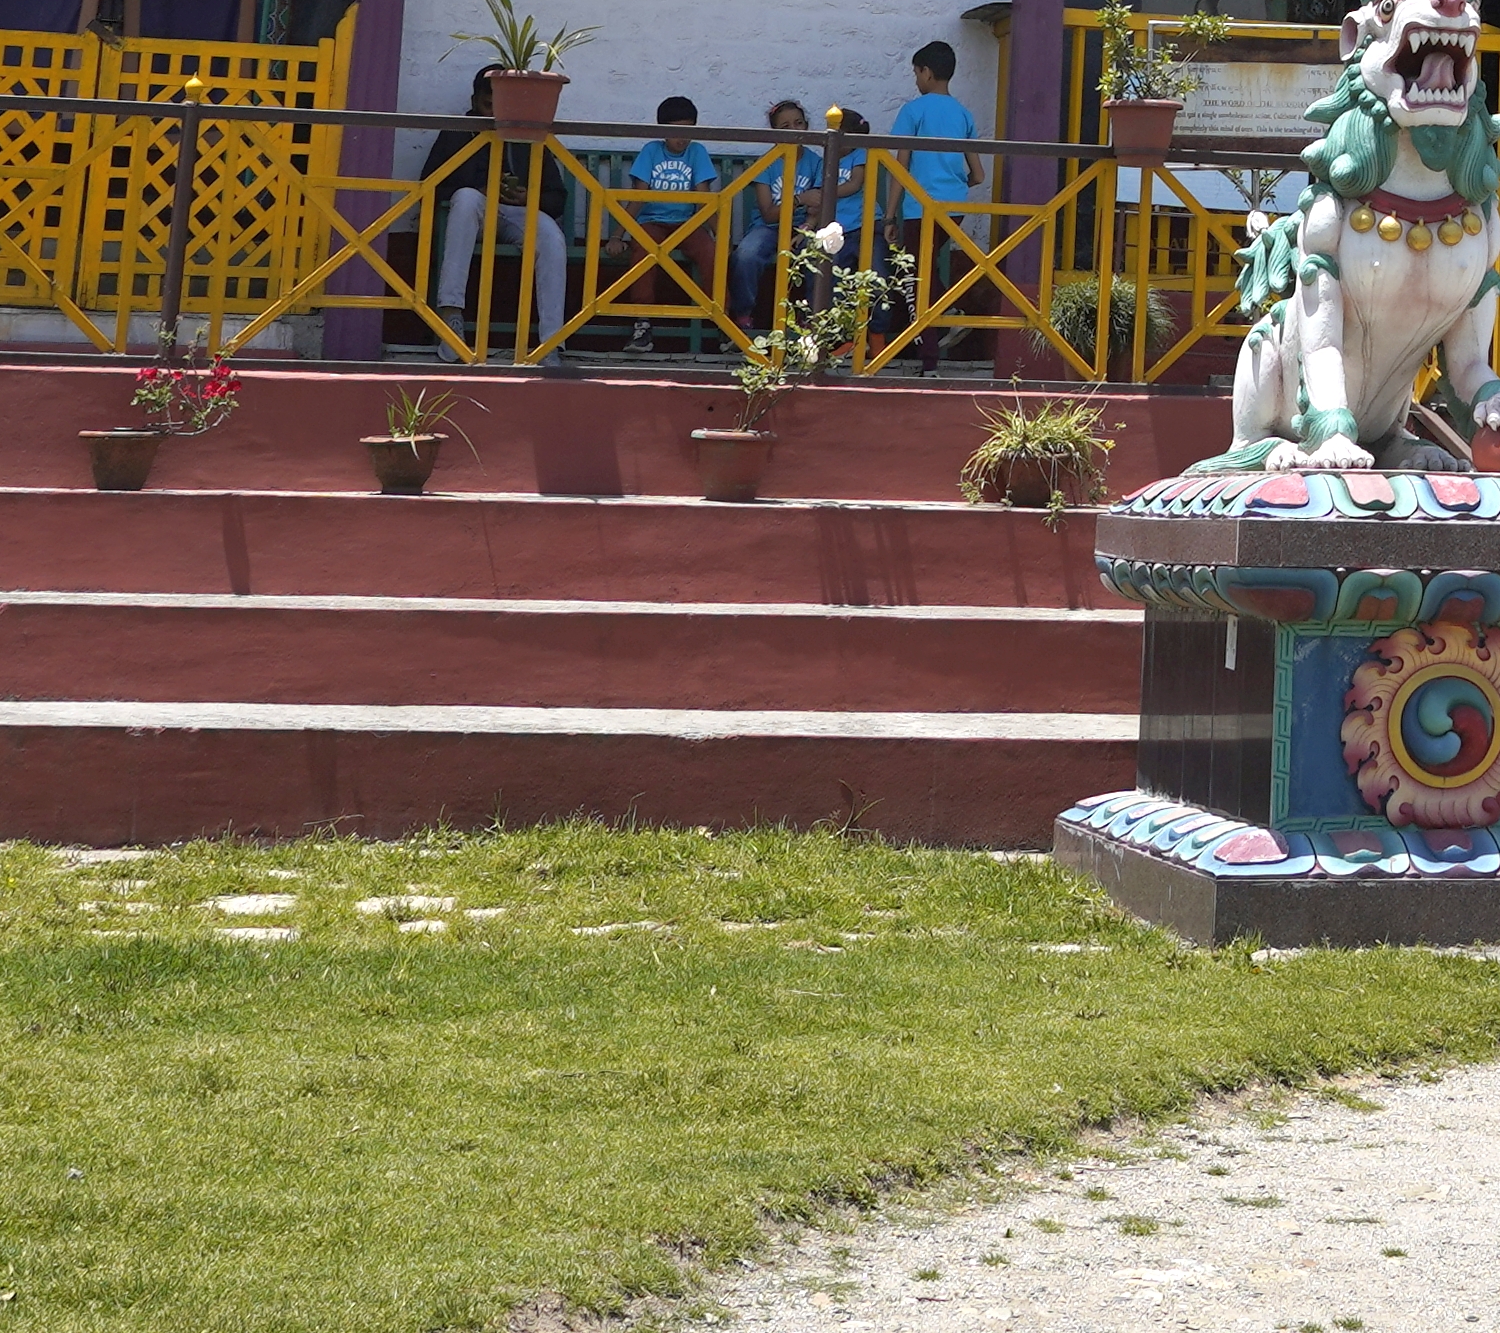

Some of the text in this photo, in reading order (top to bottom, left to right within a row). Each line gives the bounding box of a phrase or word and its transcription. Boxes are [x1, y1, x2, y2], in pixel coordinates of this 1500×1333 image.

[1203, 99, 1219, 107] THE
[1220, 100, 1245, 108] WORD
[1221, 124, 1234, 132] mind
[1257, 125, 1268, 133] This
[1284, 125, 1306, 135] teaching
